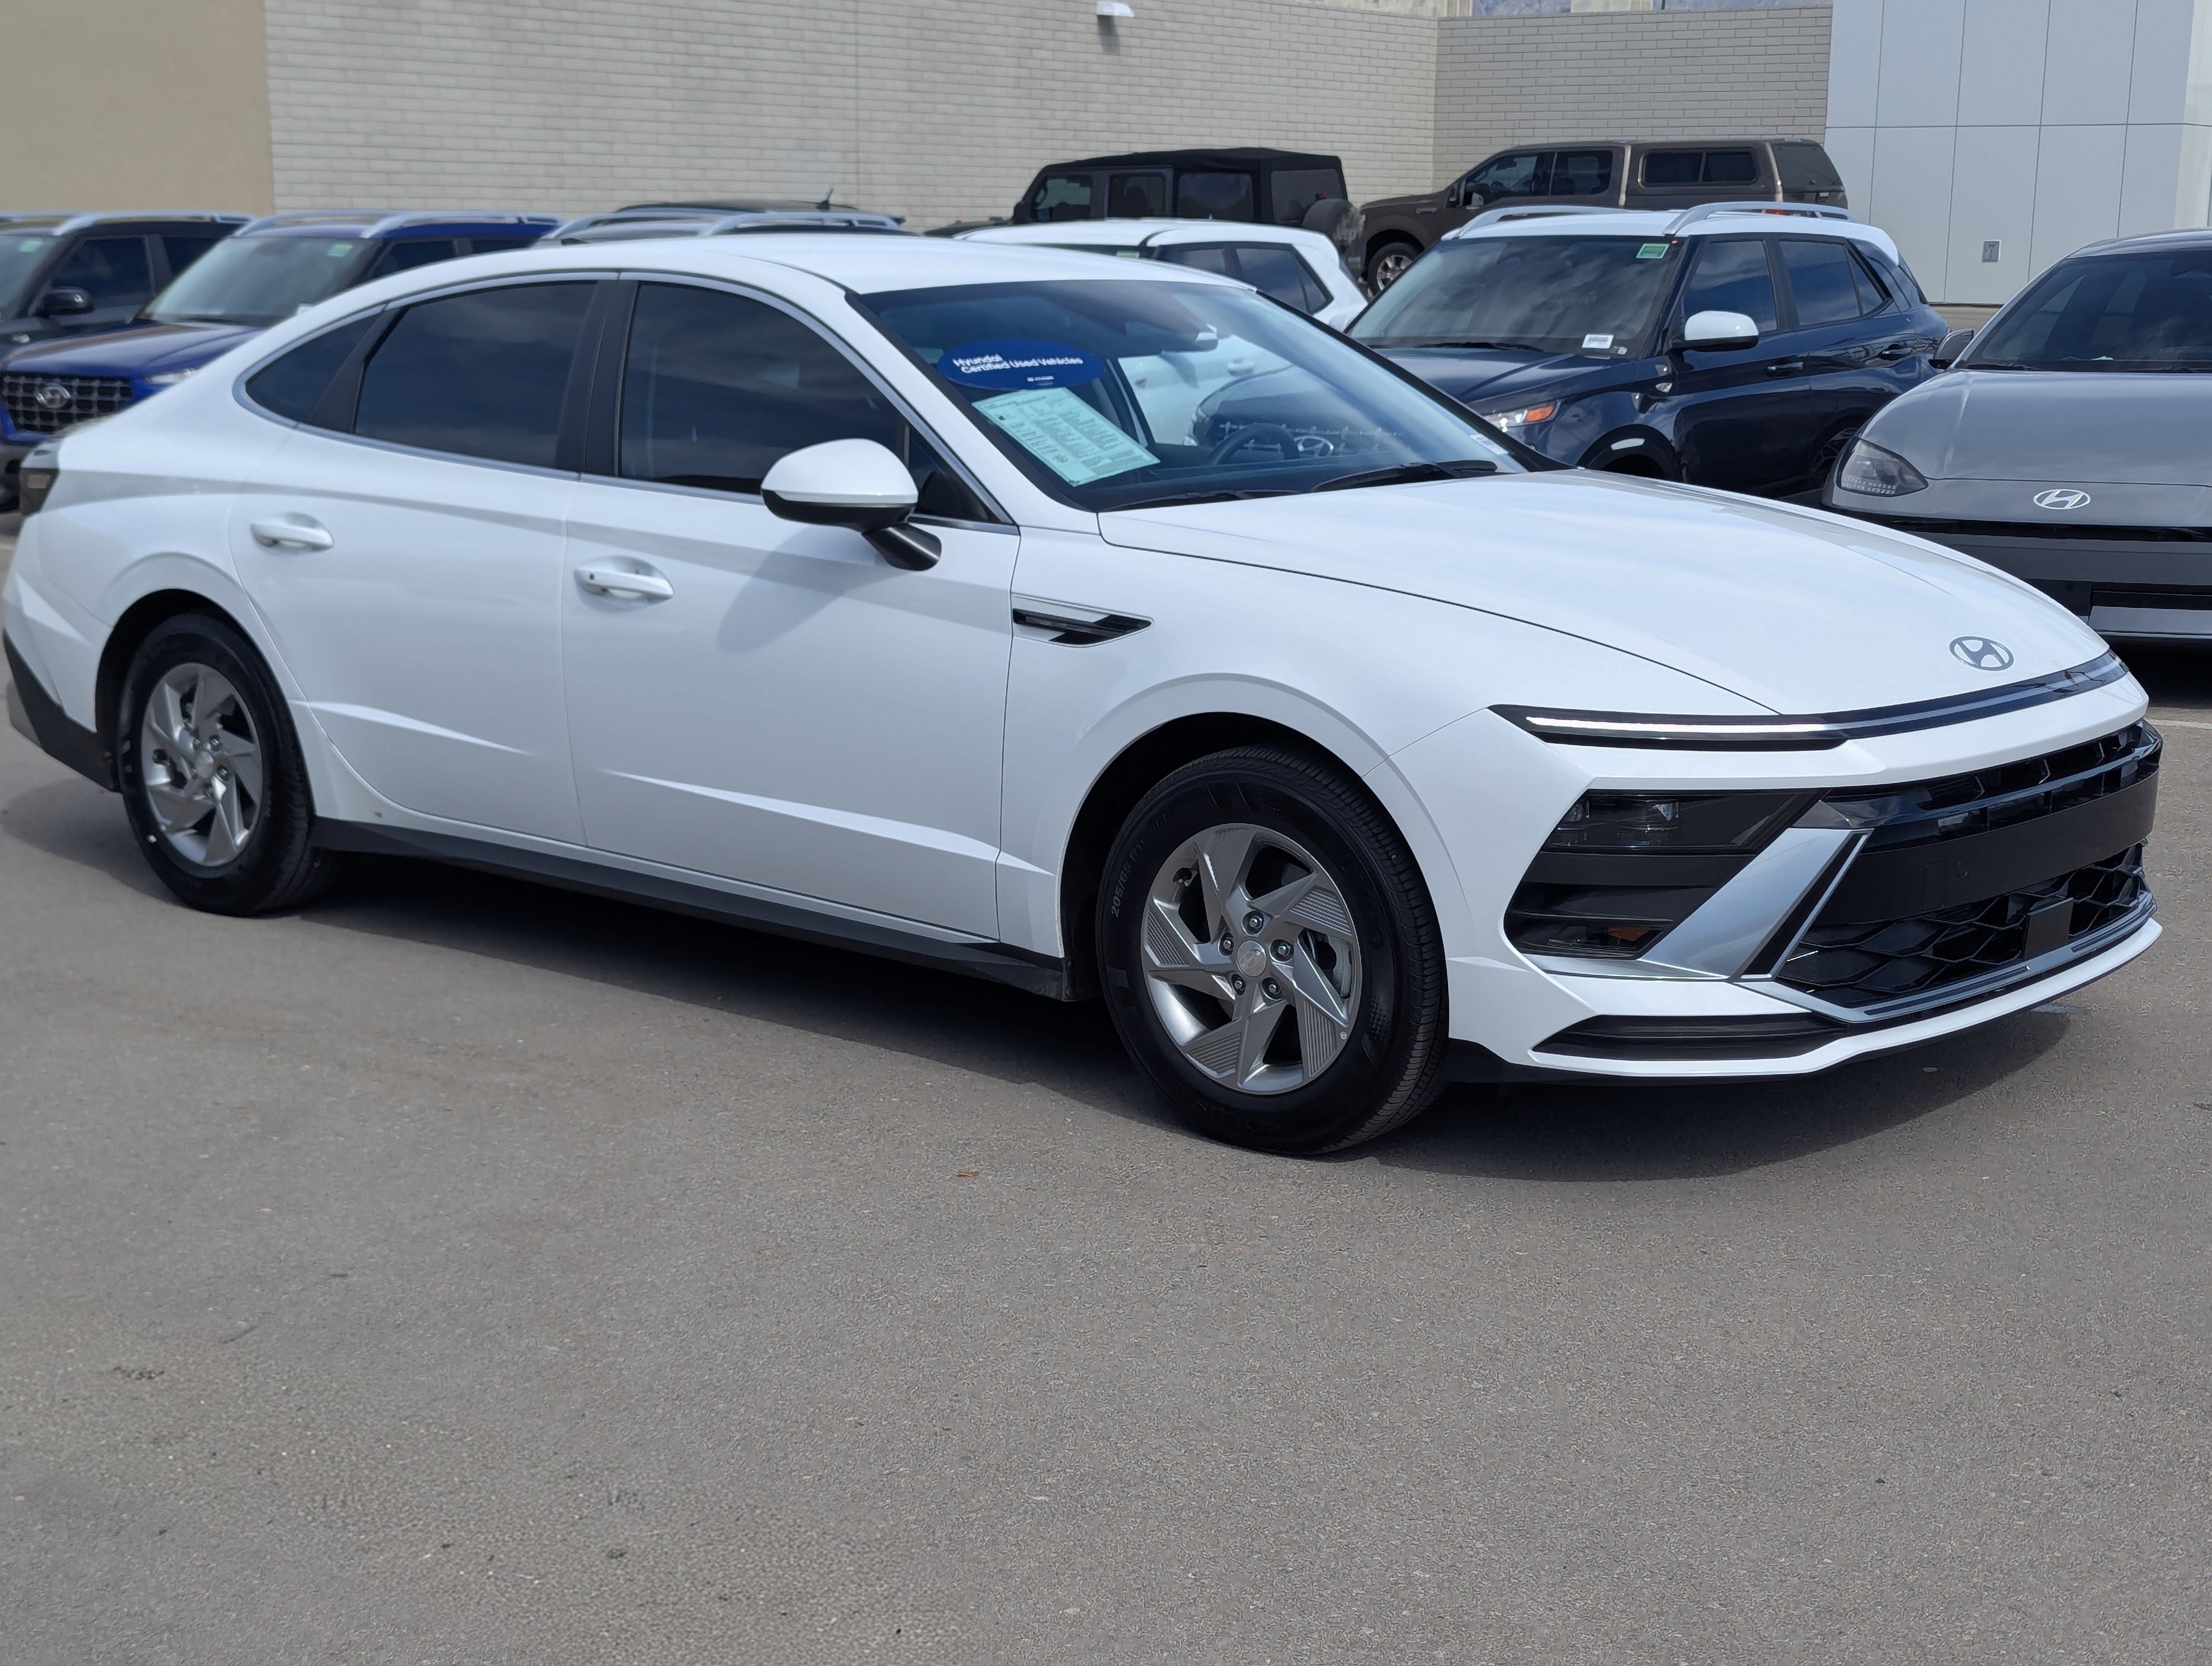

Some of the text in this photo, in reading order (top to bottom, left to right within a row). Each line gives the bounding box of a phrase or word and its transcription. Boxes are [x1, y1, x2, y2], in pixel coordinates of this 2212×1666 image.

[953, 353, 1003, 367] Hyundai
[961, 357, 1084, 374] Certified Used Vehicles
